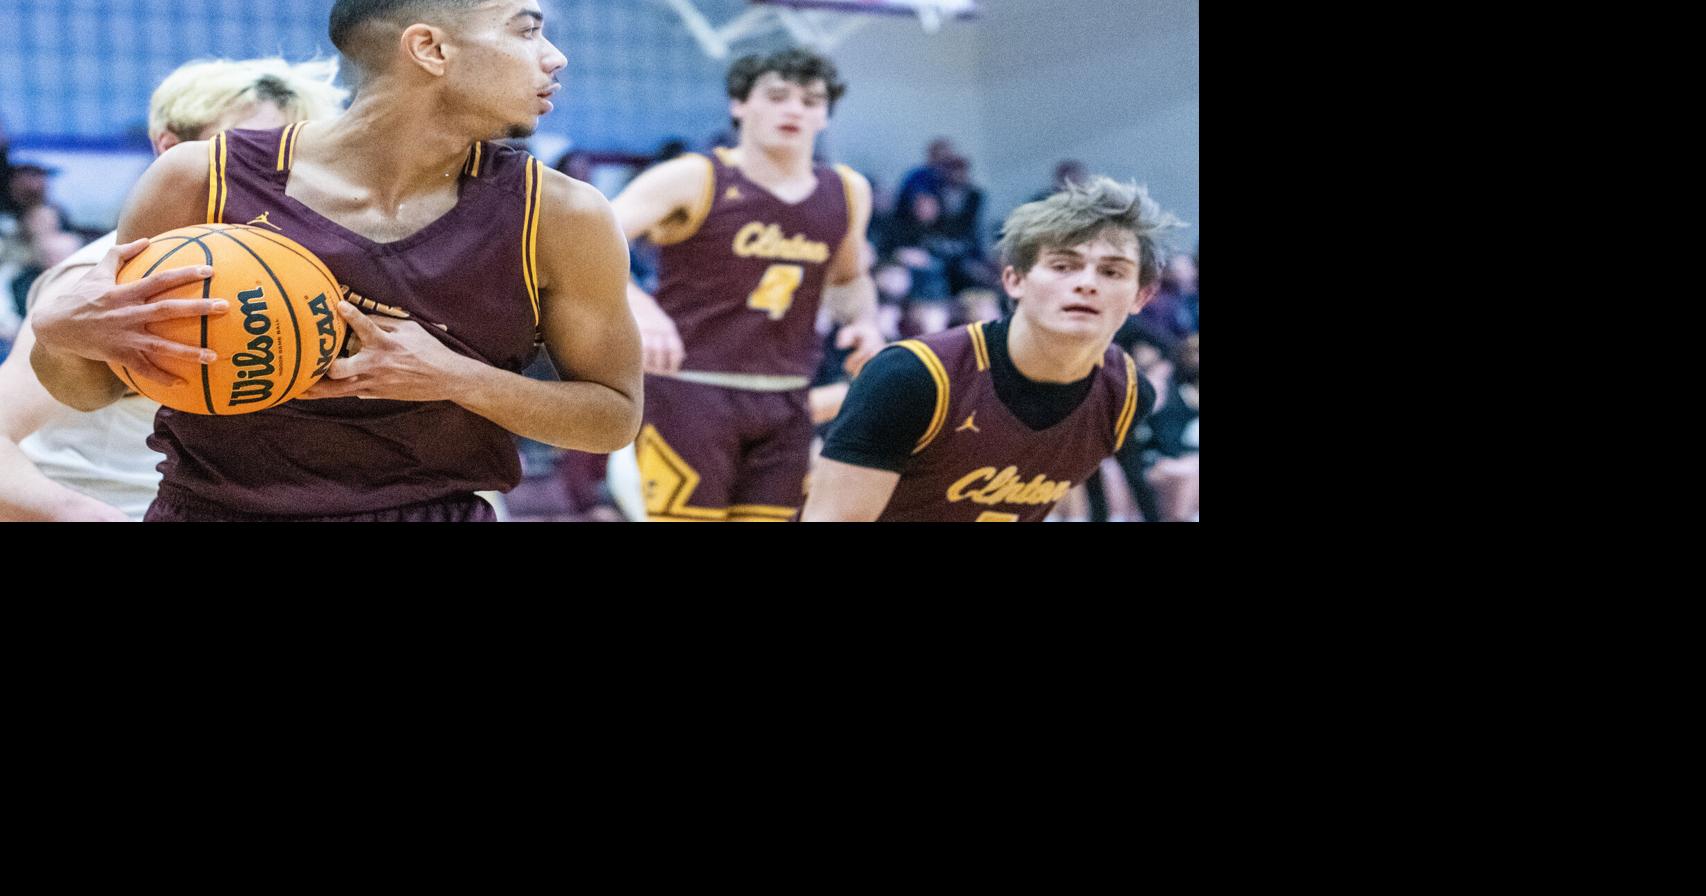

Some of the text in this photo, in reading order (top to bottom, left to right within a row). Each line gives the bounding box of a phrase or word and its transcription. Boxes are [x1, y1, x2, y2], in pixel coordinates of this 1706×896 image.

[732, 221, 830, 263] Clinton
[229, 285, 275, 406] Wilson
[310, 292, 337, 379] NCAA
[946, 465, 1071, 505] Clinton
